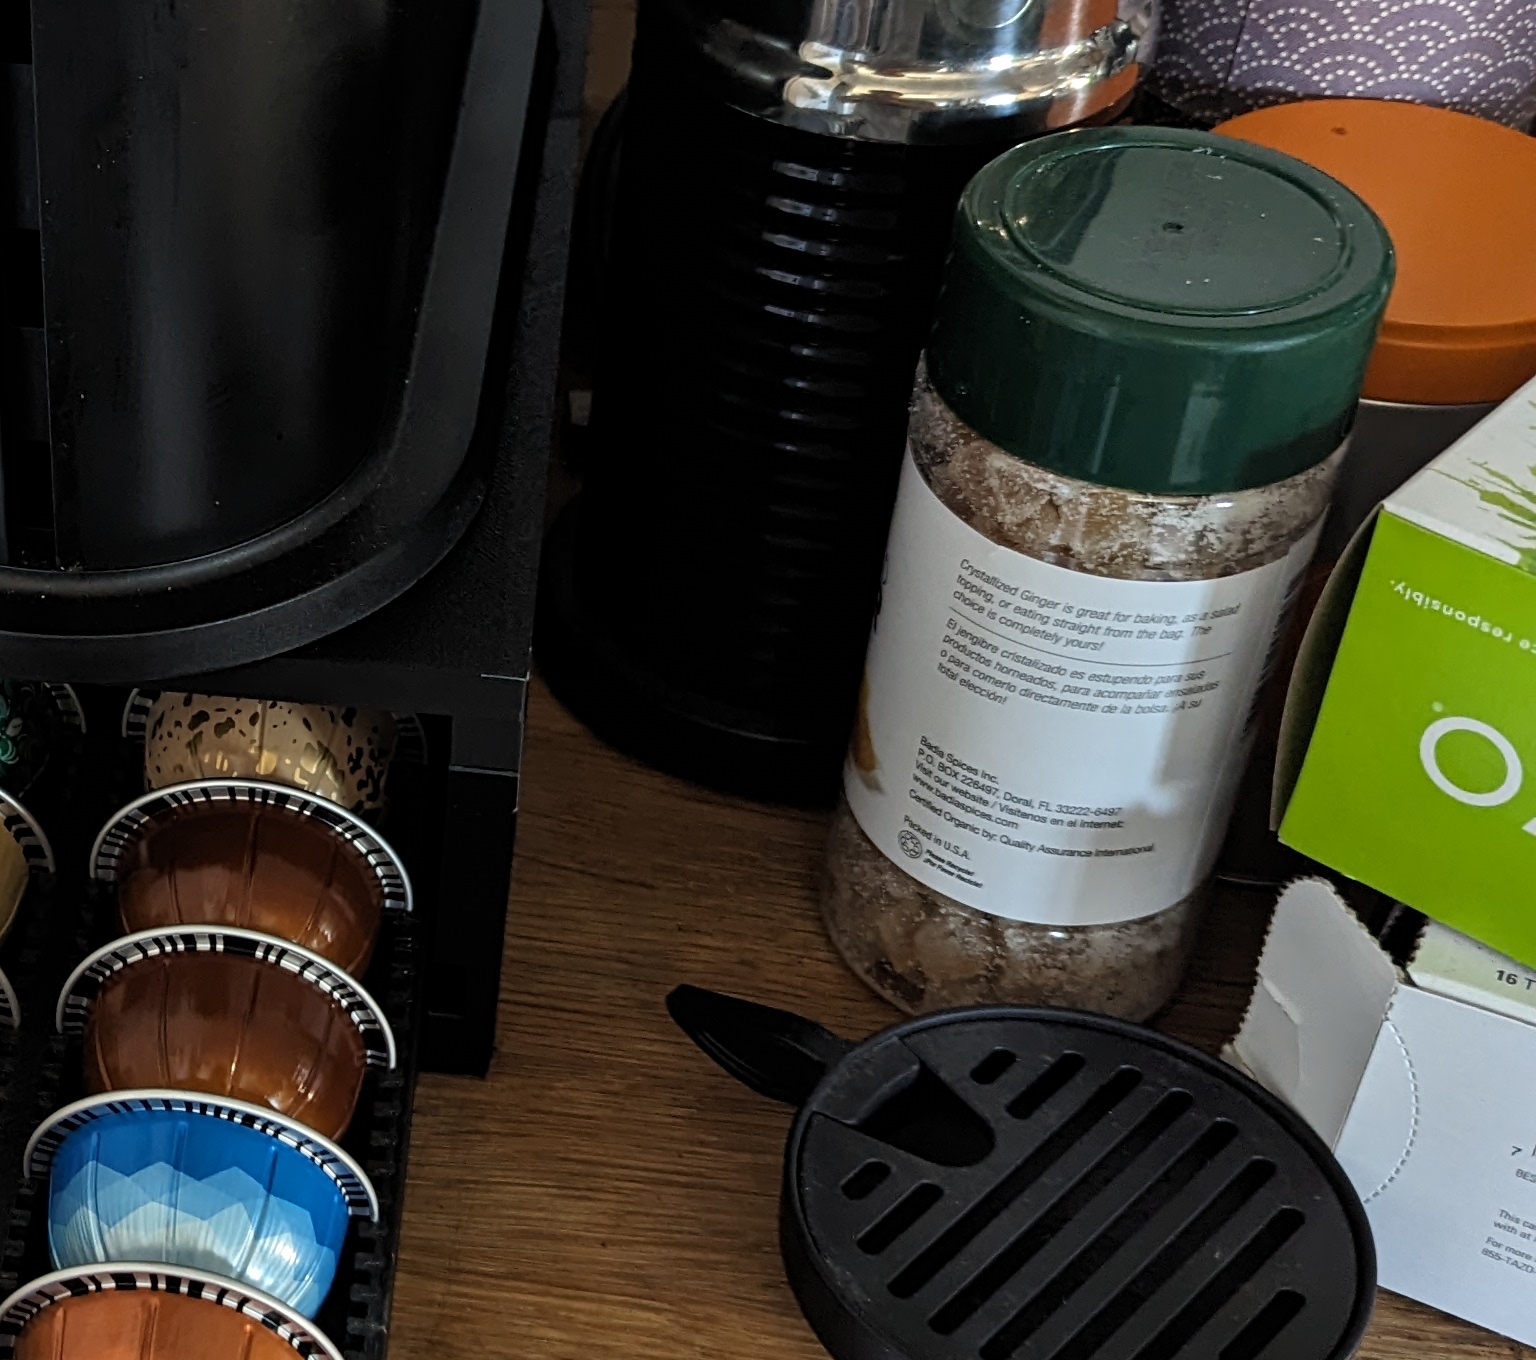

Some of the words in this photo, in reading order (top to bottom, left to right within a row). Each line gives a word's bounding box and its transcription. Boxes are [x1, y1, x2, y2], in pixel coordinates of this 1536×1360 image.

[956, 574, 995, 604] topping,
[998, 598, 1014, 609] or
[1013, 605, 1051, 626] eating
[1052, 618, 1102, 636] straight
[1103, 626, 1134, 639] from
[1135, 629, 1157, 639] the
[1158, 629, 1184, 640] bag.
[960, 559, 1019, 596] Crystallized
[1020, 590, 1061, 610] Ginger
[1062, 602, 1074, 614] is
[1076, 607, 1112, 621] great
[1112, 611, 1133, 623] for
[1133, 614, 1178, 626] baking,
[1390, 580, 1512, 642] responsibly.
[953, 590, 985, 613] choice
[986, 608, 997, 620] is
[998, 615, 1064, 645] completely
[1064, 637, 1105, 651] yours!
[942, 634, 993, 668] productos
[1060, 683, 1091, 697] para
[946, 617, 958, 630] El
[955, 626, 1000, 654] jengibre
[1000, 649, 1067, 676] cristalizado
[1069, 670, 1085, 680] es
[1087, 673, 1154, 686] estupendo
[937, 661, 960, 682] total
[959, 677, 1008, 706] elección!
[947, 655, 971, 673] para
[1018, 687, 1099, 712] directamente
[1101, 703, 1118, 714] de
[1119, 704, 1133, 715] la
[917, 747, 936, 767] P.O.
[937, 761, 960, 781] BOX
[1003, 791, 1034, 809] Doral,
[1038, 801, 1053, 813] FL
[1055, 804, 1123, 817] 33222-6497
[945, 752, 979, 776] Spices
[981, 769, 1000, 785] Inc.
[912, 773, 1019, 830] www.badiaspices.com
[933, 775, 950, 787] our
[951, 784, 990, 807] website
[1050, 818, 1064, 827] en
[1066, 819, 1077, 828] el
[904, 814, 933, 841] Packed
[933, 834, 943, 847] in
[943, 839, 972, 861] U.S.A.
[943, 811, 980, 835] Organic
[981, 828, 998, 842] by:
[999, 834, 1037, 854] Quality
[1497, 970, 1518, 985] 16
[1494, 1221, 1518, 1235] with
[1519, 1231, 1532, 1241] at
[1500, 1208, 1521, 1224] This
[1485, 1236, 1502, 1249] For
[1505, 1245, 1532, 1261] more
